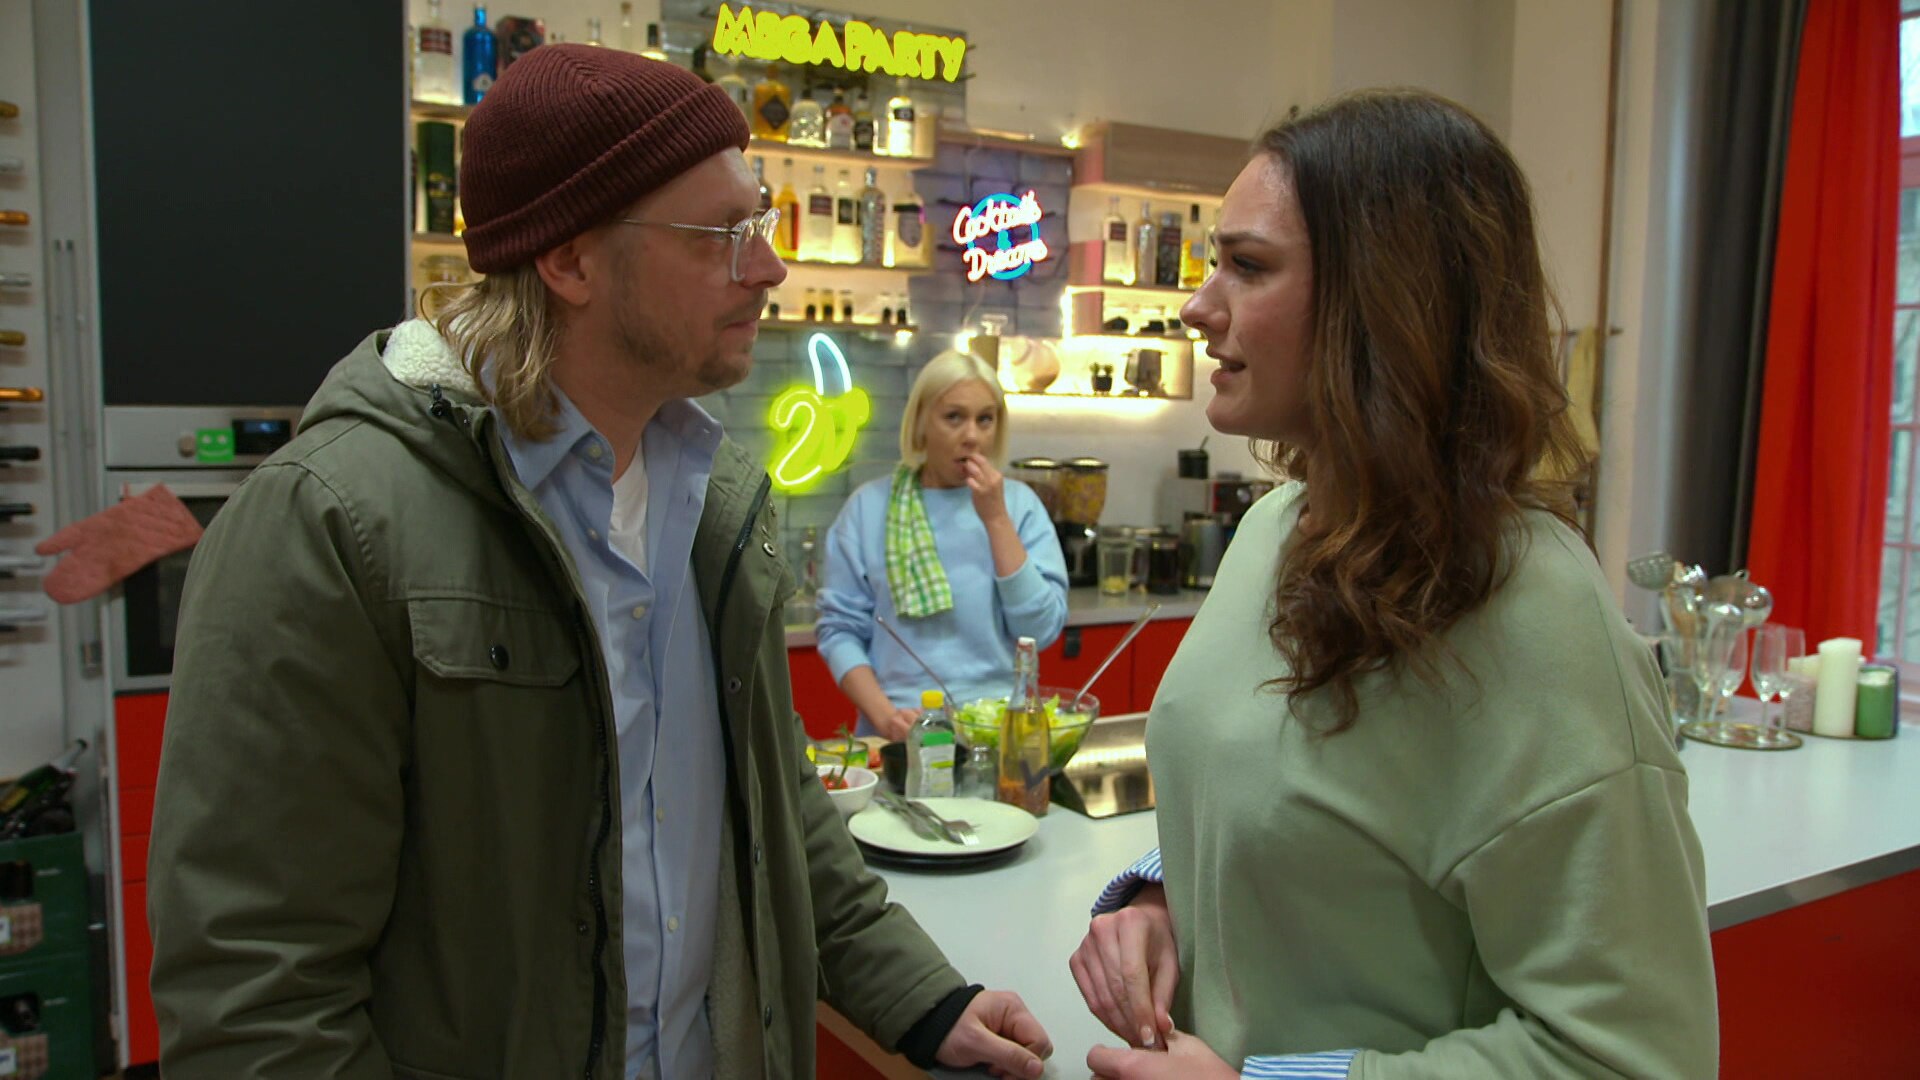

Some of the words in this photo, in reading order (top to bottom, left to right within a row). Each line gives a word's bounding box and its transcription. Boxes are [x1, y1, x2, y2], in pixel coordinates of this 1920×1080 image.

[713, 3, 844, 67] MEGA
[845, 20, 965, 83] PARTY
[953, 190, 1042, 244] Cocktails
[963, 239, 1048, 282] Dreams
